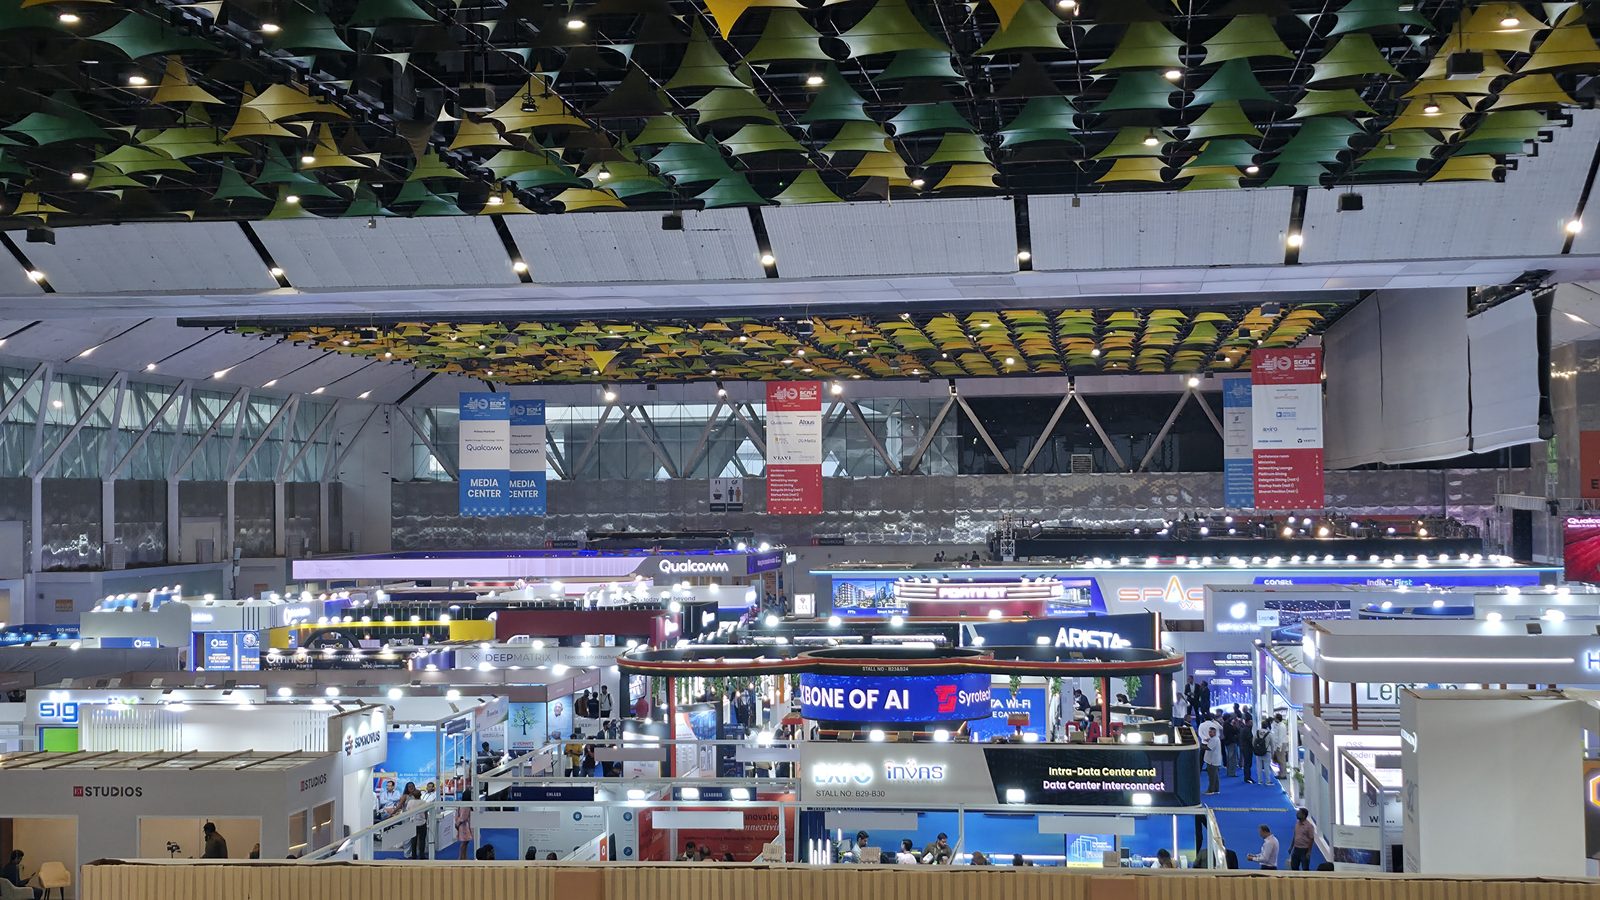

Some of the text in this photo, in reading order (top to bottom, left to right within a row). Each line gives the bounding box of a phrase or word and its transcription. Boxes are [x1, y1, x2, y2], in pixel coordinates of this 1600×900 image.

[466, 443, 502, 451] Qualcomm
[470, 479, 499, 487] MEDIA
[509, 479, 536, 488] MEDIA
[467, 489, 501, 498] CENTER
[659, 559, 729, 574] Qualcomm
[1055, 627, 1122, 649] ARISTA
[849, 688, 880, 710] OF
[884, 689, 909, 710] AI
[1048, 766, 1157, 777] Intra-Data Center and
[1043, 780, 1166, 791] Data Center Interconnect
[84, 786, 143, 797] STUDIOS
[816, 789, 839, 797] STALL
[855, 790, 886, 798] B29-B30
